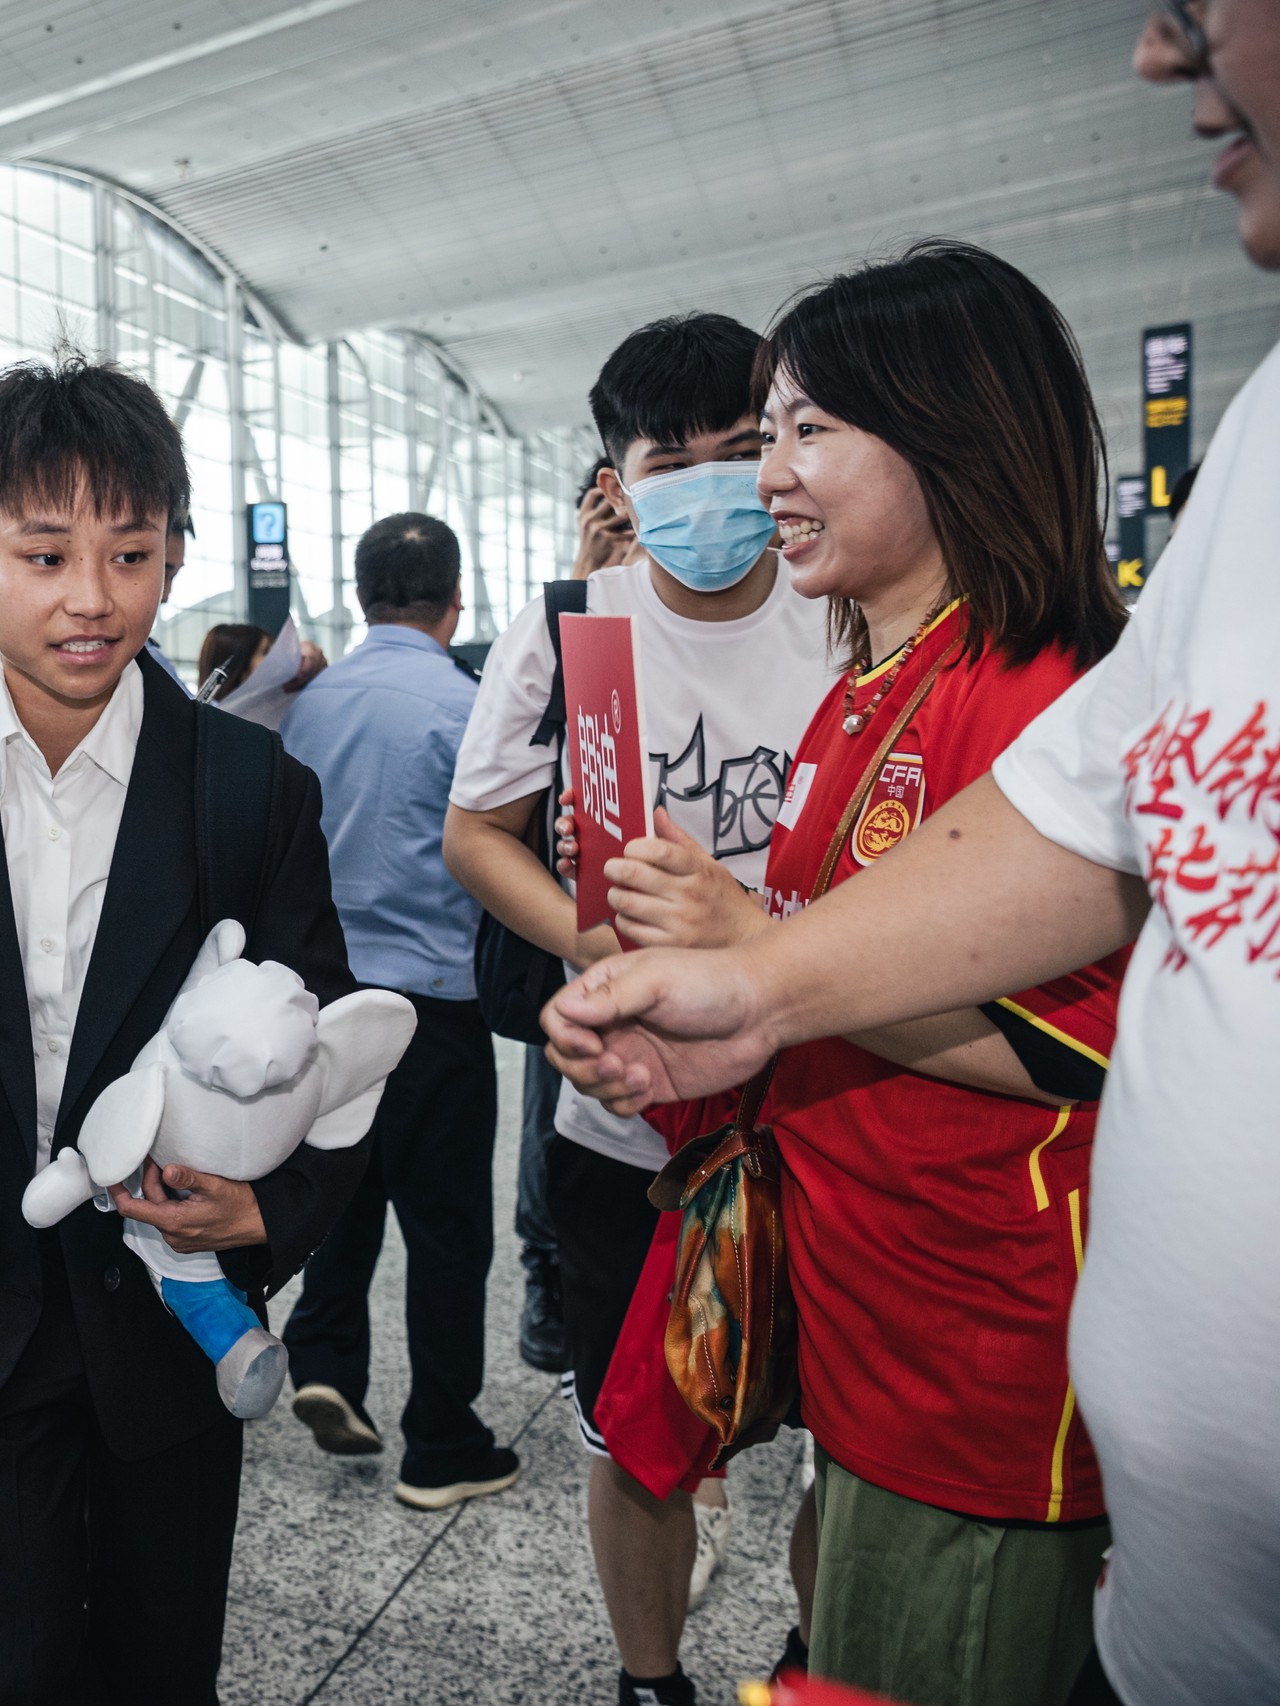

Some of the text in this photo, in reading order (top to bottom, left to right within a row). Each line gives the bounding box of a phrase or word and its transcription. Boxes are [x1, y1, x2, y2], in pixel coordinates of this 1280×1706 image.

[1151, 465, 1171, 507] L
[1118, 559, 1144, 587] K
[577, 704, 623, 842] 朗迪
[879, 763, 922, 788] CFA
[887, 785, 905, 799] 中国
